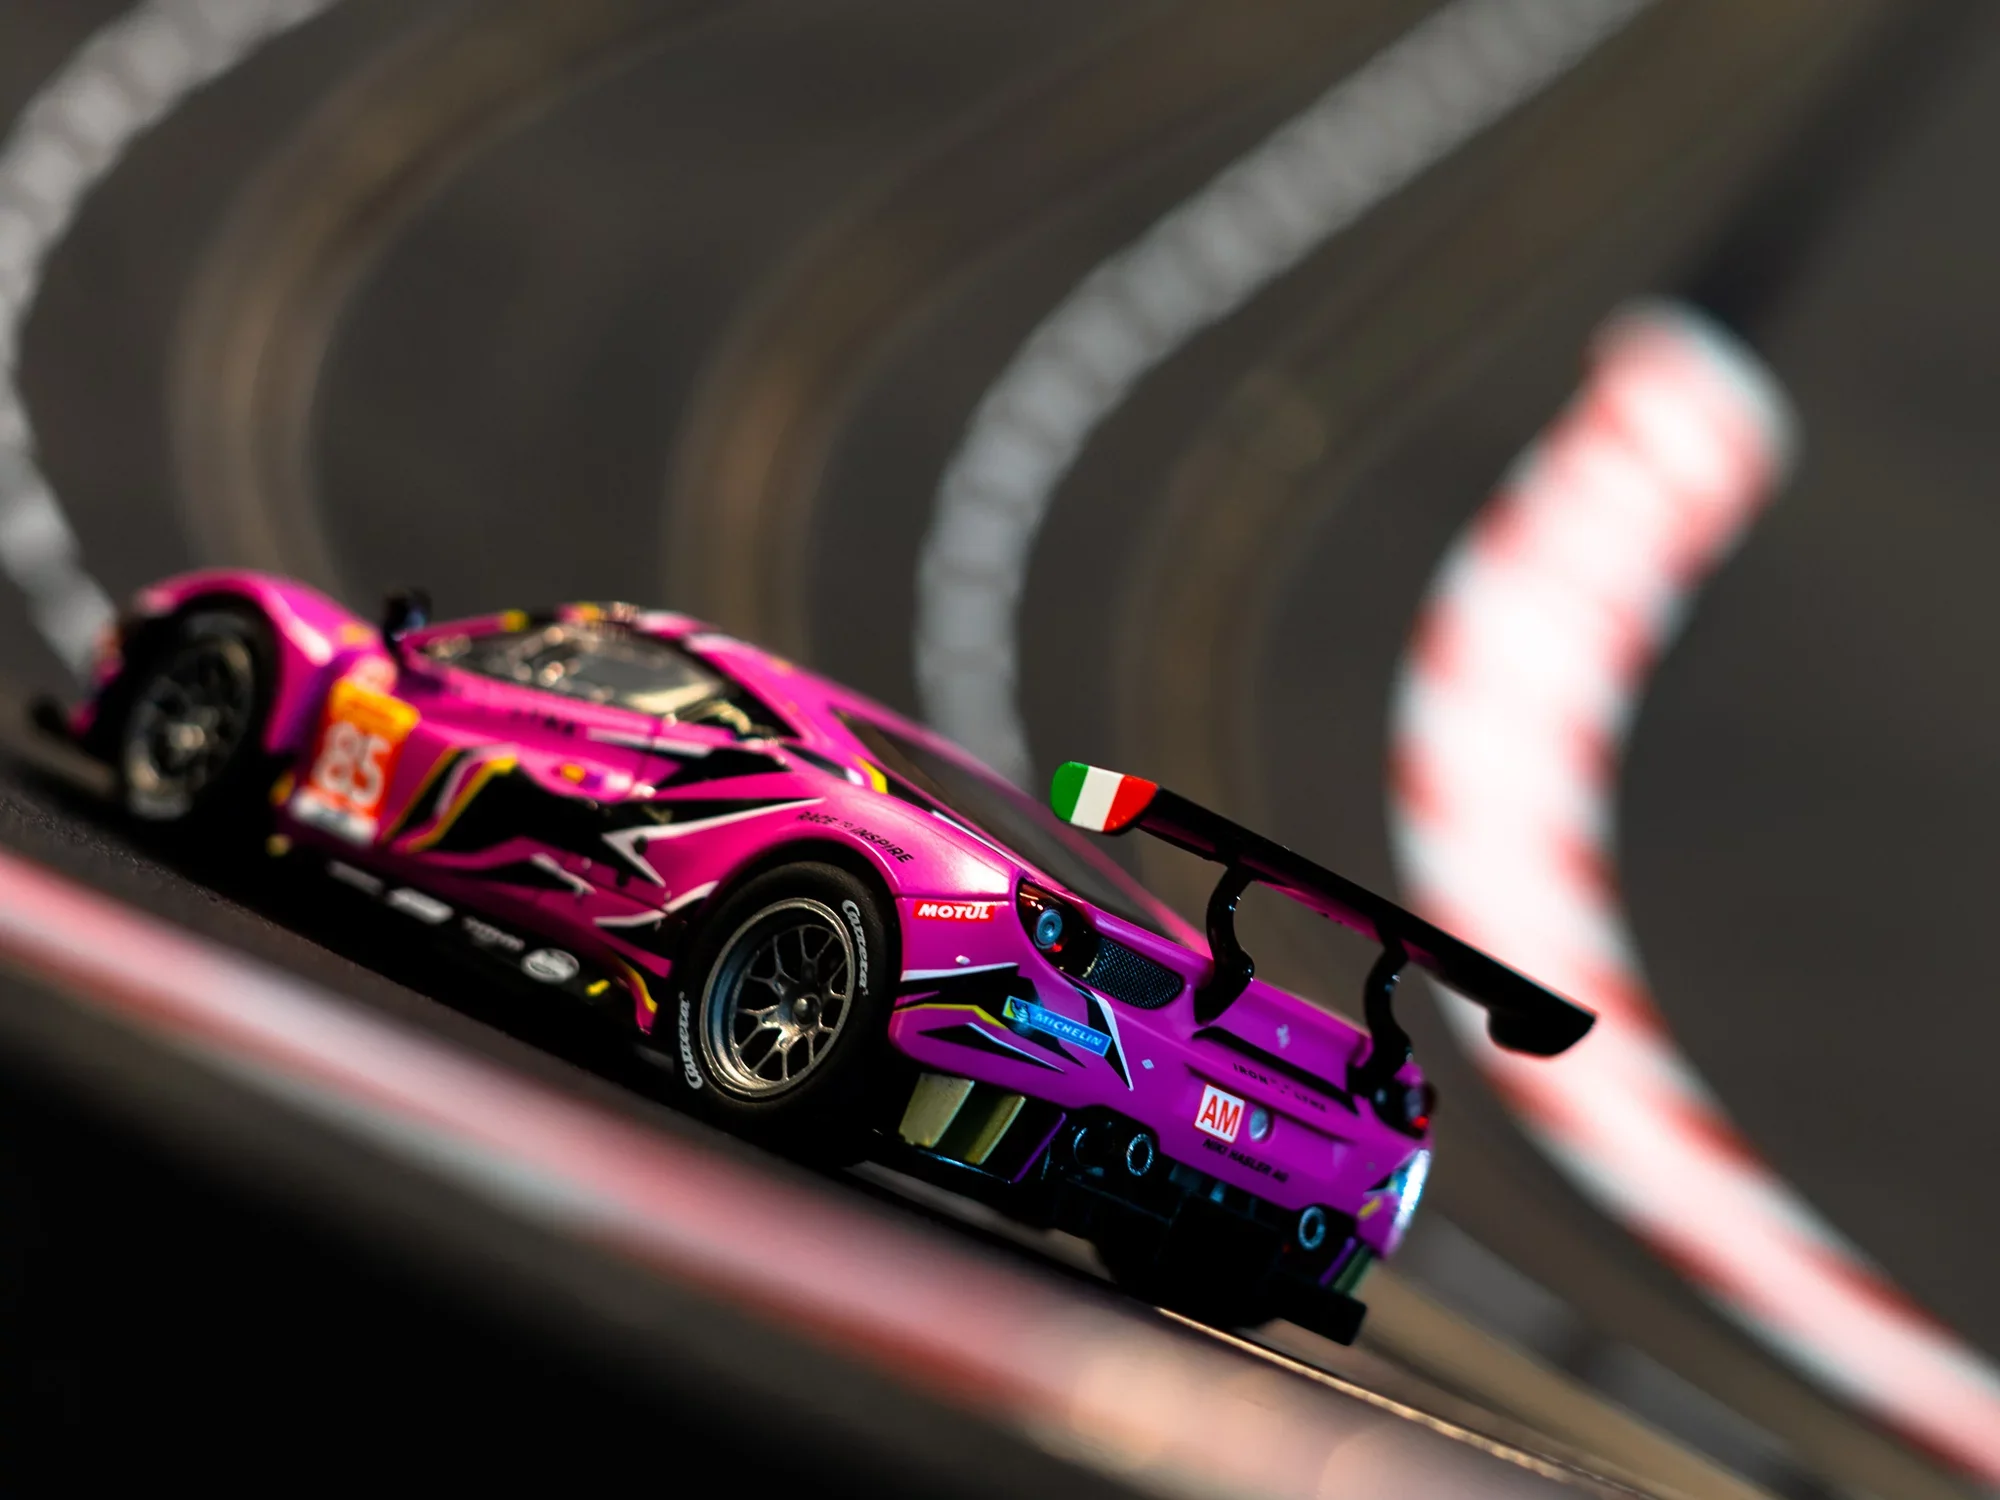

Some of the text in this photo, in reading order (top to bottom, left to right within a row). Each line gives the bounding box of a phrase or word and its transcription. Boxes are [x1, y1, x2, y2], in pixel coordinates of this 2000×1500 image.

[311, 721, 391, 807] 85
[796, 811, 838, 825] RACE
[850, 826, 914, 863] INSPIRE
[917, 903, 990, 920] MOTUL
[1034, 1013, 1104, 1047] MICHELIN
[1233, 1062, 1268, 1086] IRON
[1200, 1094, 1240, 1137] AM
